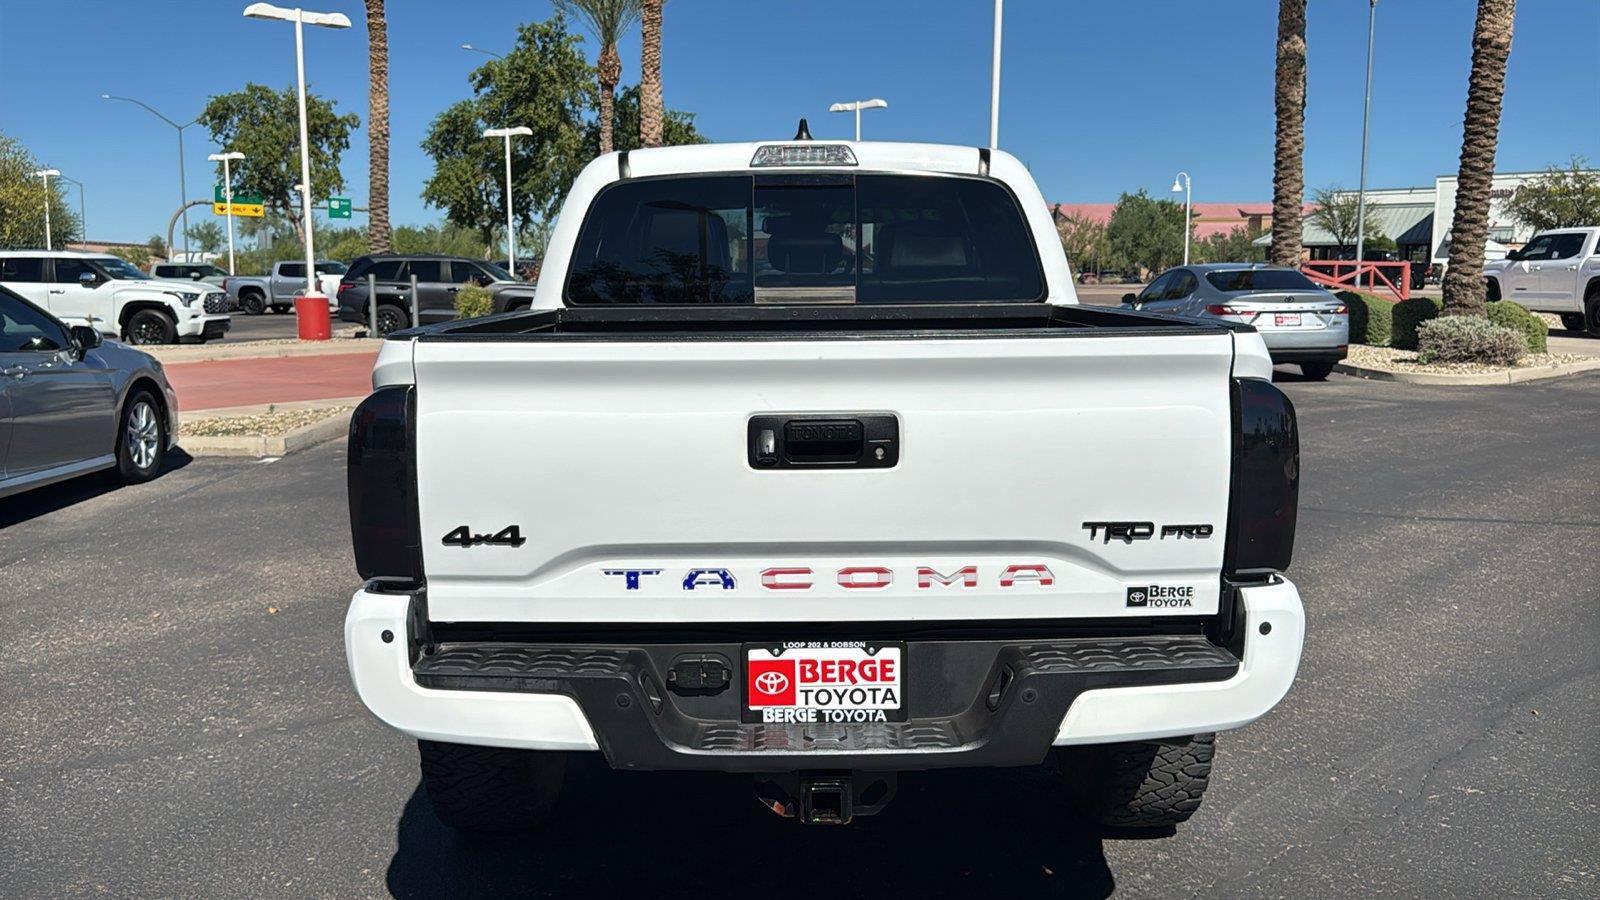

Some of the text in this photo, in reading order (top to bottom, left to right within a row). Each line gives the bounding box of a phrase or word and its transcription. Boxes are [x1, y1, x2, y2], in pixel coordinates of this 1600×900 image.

[791, 426, 857, 440] TOYOTA
[1082, 522, 1214, 544] TRD PRO
[601, 565, 1056, 590] TACOMA
[1149, 585, 1193, 598] BERGE
[1149, 598, 1192, 607] TOYOTA
[799, 659, 896, 685] BERGE
[800, 688, 898, 706] TOYOTA
[762, 707, 887, 724] BERGE TOYOTA
